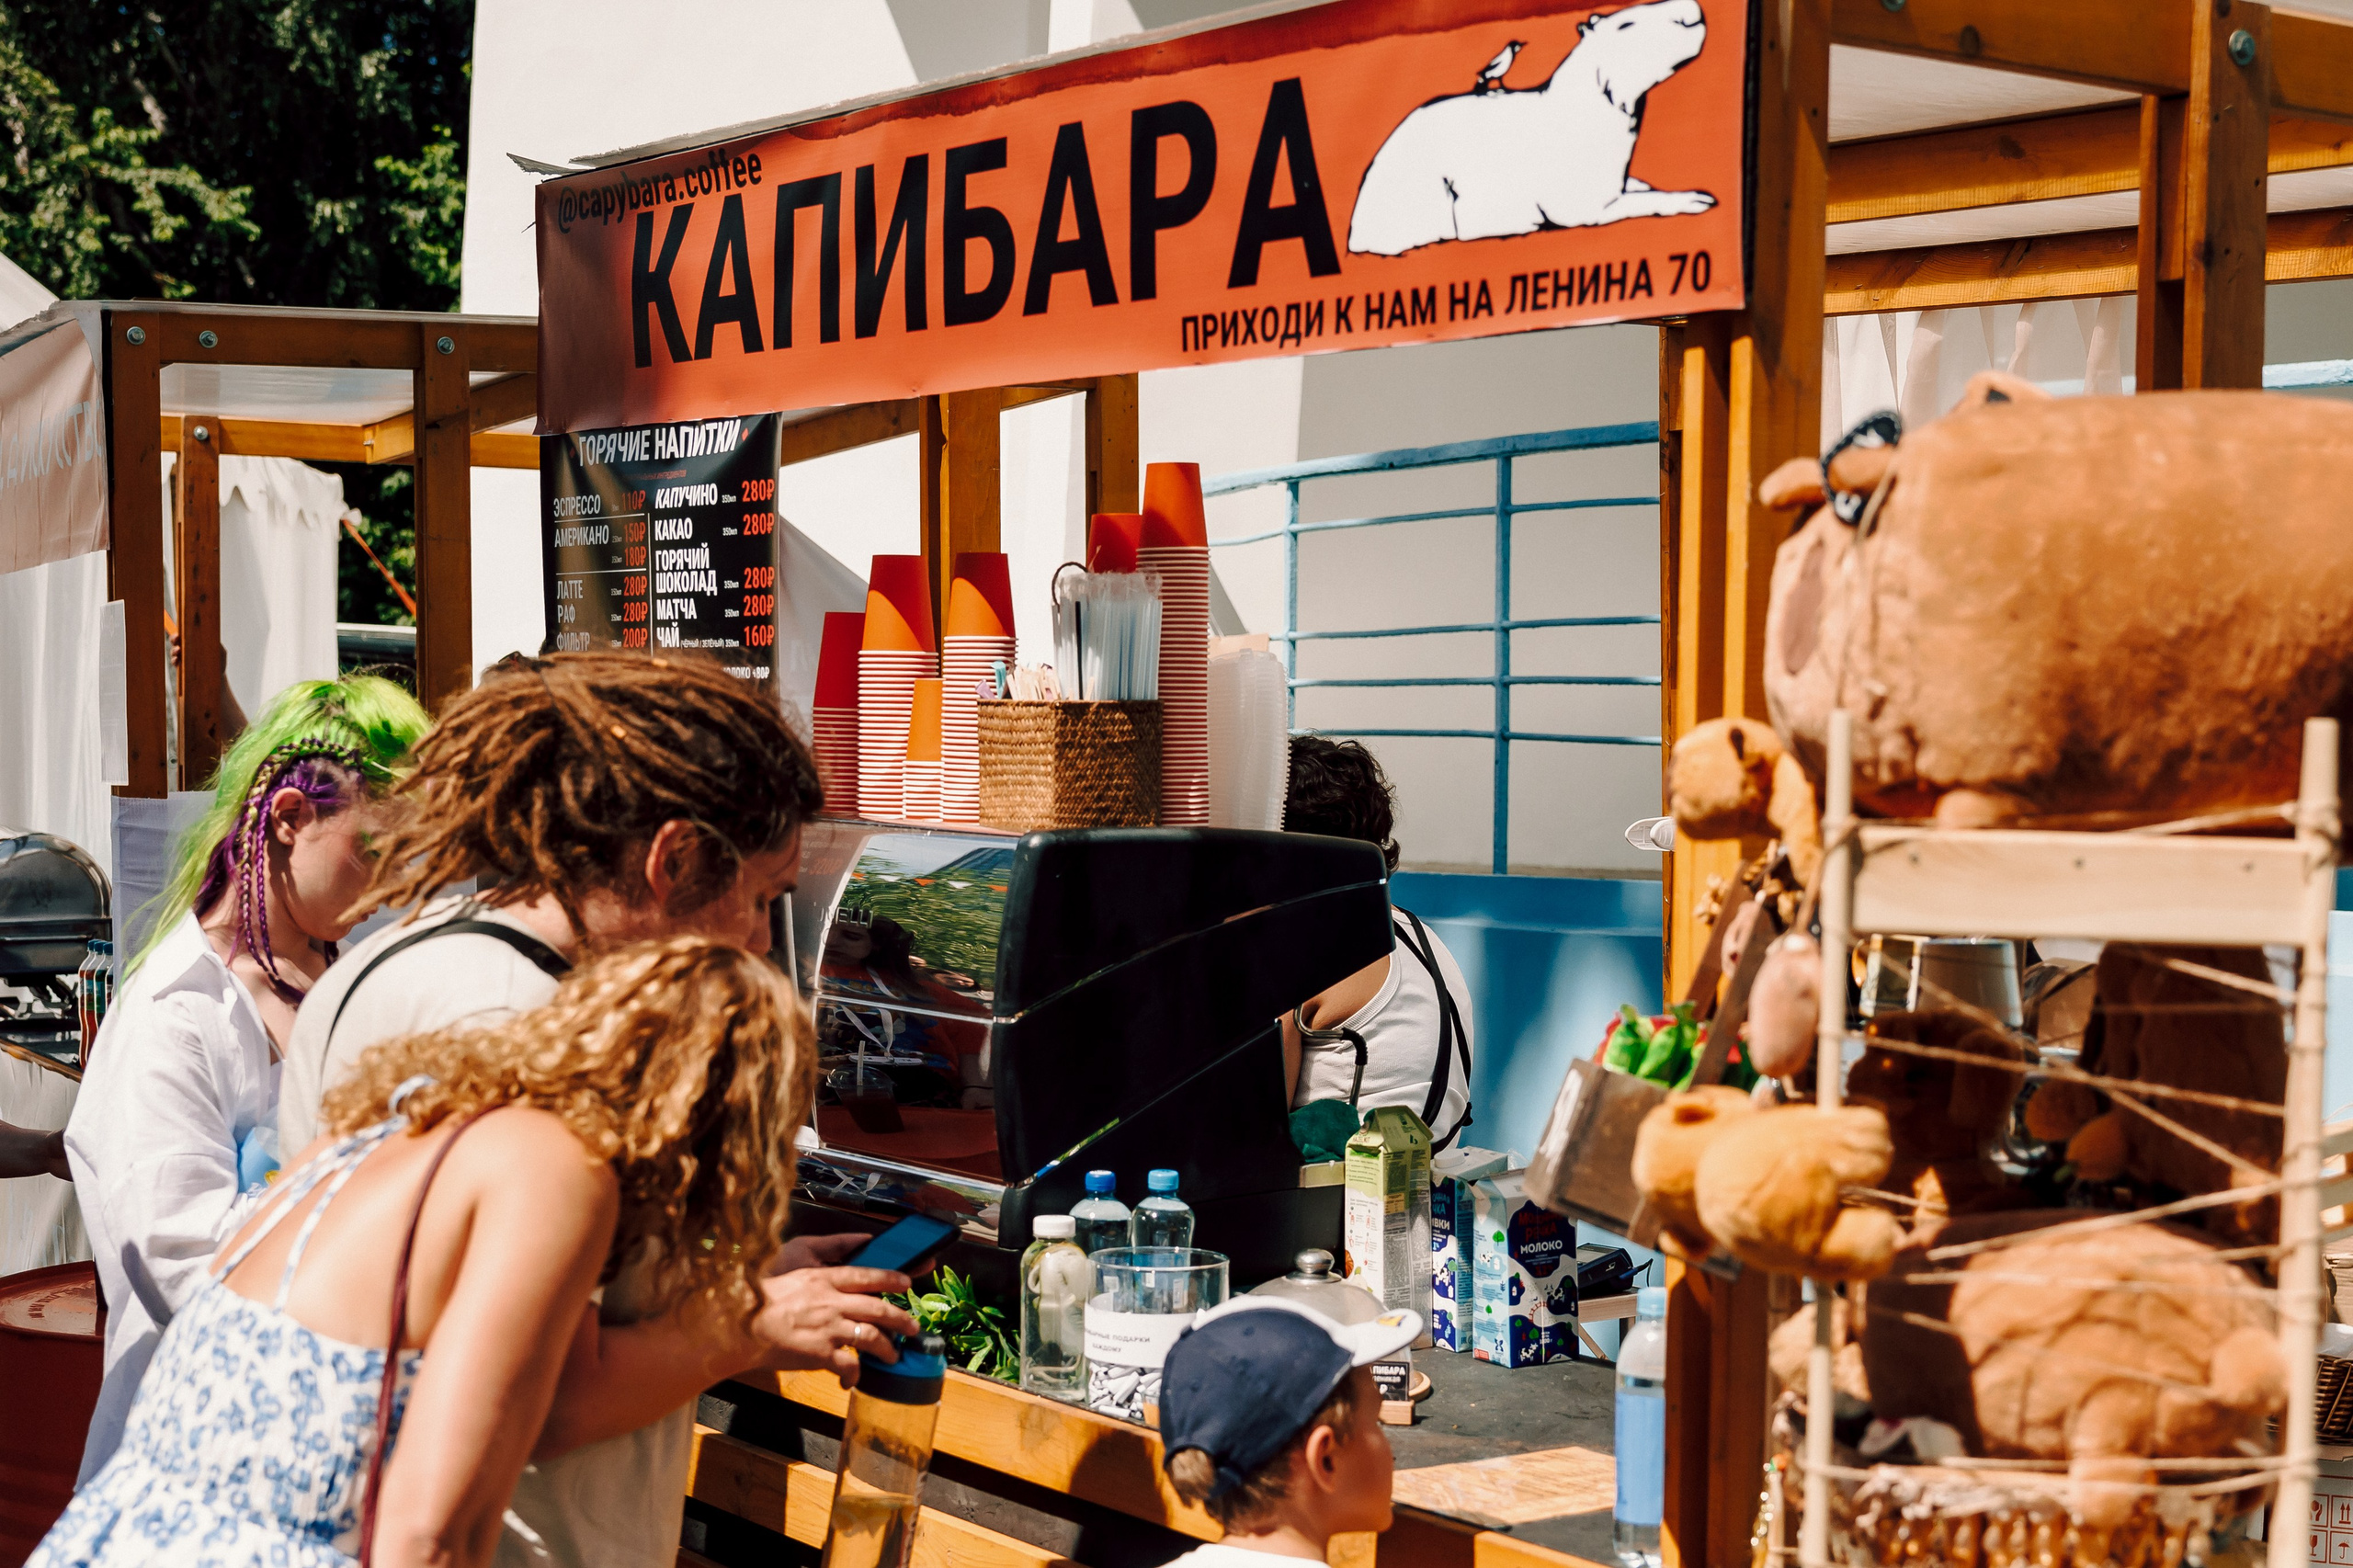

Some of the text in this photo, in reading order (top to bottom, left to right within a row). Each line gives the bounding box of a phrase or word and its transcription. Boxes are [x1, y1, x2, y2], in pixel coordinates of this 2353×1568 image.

[558, 147, 762, 233] @capybara.coffee
[631, 77, 1342, 368] КАПИБАРА
[1181, 249, 1711, 353] ПРИХОДИ К НАМ НА ЛЕНИНА 70
[578, 418, 742, 467] ГОРЯЧИЕ НАПИТКИ
[553, 494, 601, 517] ЭСПРЕССО
[654, 483, 719, 509] КАПУЧИНО
[742, 478, 775, 503] 280₽
[554, 524, 610, 548] АМЕРИКАНО
[624, 521, 646, 543] 150₽
[654, 517, 693, 541] КАКАО
[743, 512, 775, 537] 280₽
[624, 546, 647, 567] 180₽
[655, 542, 710, 572] ГОРЯЧИЙ
[557, 579, 584, 600] ЛАТТЕ
[623, 575, 648, 597] 280₽
[655, 570, 718, 597] ШОКОЛАД
[744, 566, 775, 589] 280₽
[557, 603, 576, 624] РАФ
[623, 601, 648, 622] 280₽
[656, 597, 698, 620] МАТЧА
[743, 594, 775, 617] 280₽
[556, 631, 591, 653] ФИЛЬТР
[622, 627, 648, 648] 200₽
[656, 621, 680, 648] ЧАЙ
[744, 624, 775, 647] 160₽
[723, 665, 751, 679] ОЛОКО
[1519, 1239, 1563, 1255] МОЛОКО
[1112, 1334, 1151, 1343] ПОДАРКИ
